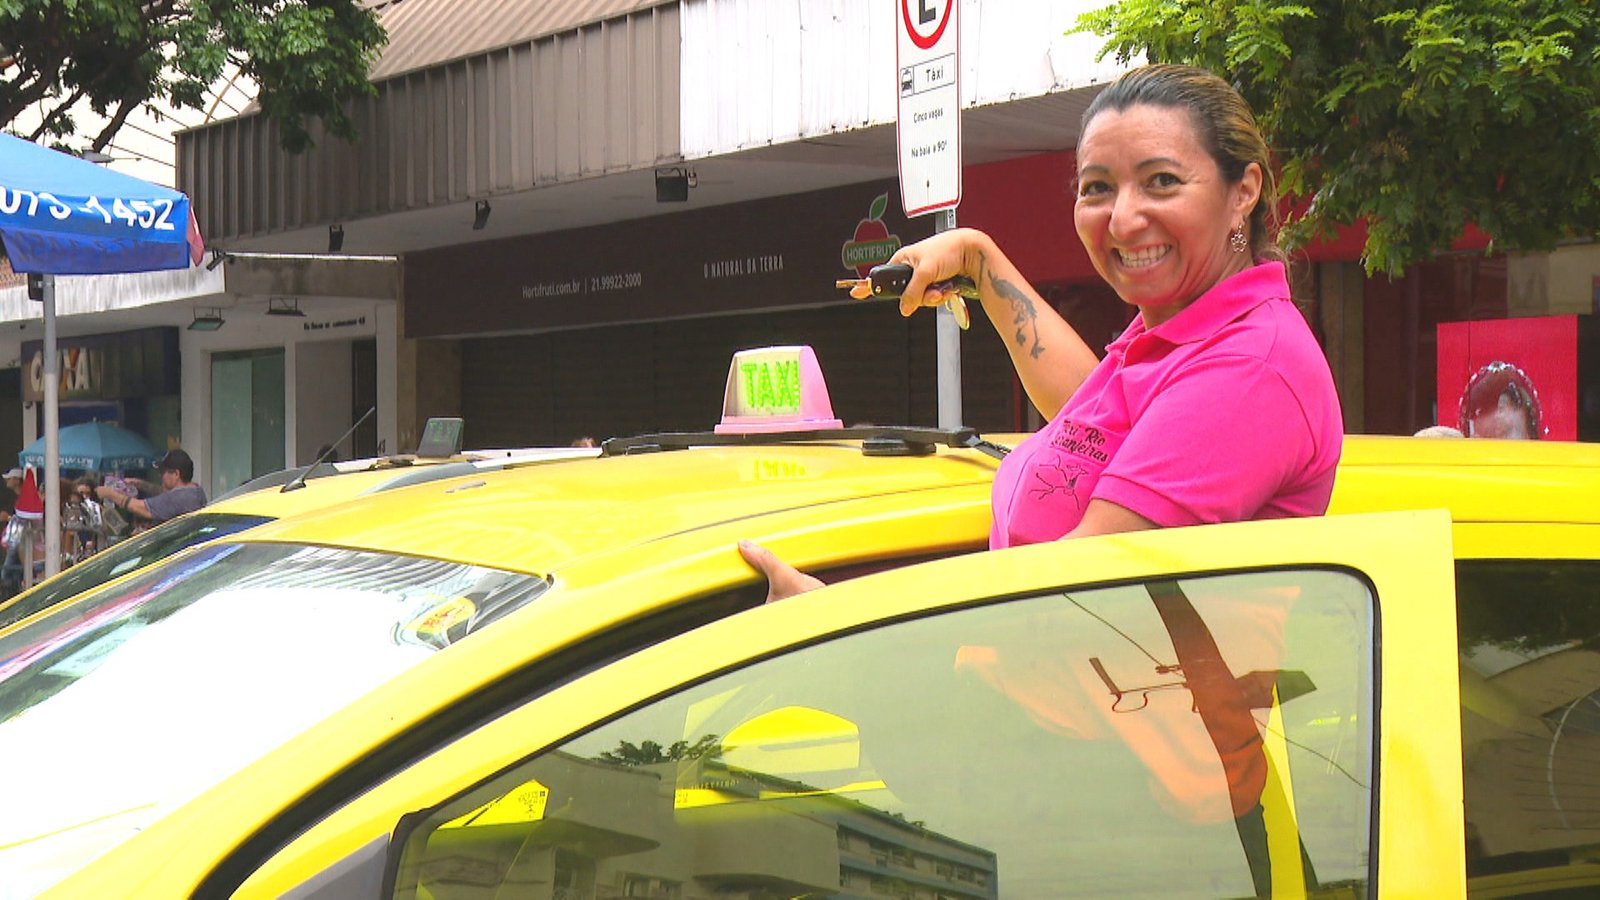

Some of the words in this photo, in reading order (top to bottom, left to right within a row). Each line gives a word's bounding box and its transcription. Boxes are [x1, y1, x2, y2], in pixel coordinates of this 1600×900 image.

[913, 112, 927, 124] Cinco
[928, 107, 944, 121] vagas
[711, 259, 744, 278] NATURAL
[746, 257, 757, 274] DA
[760, 253, 784, 273] TERRA
[522, 280, 581, 299] Hortifruti.com.br
[741, 361, 800, 408] TAXI
[1085, 427, 1106, 447] Rio
